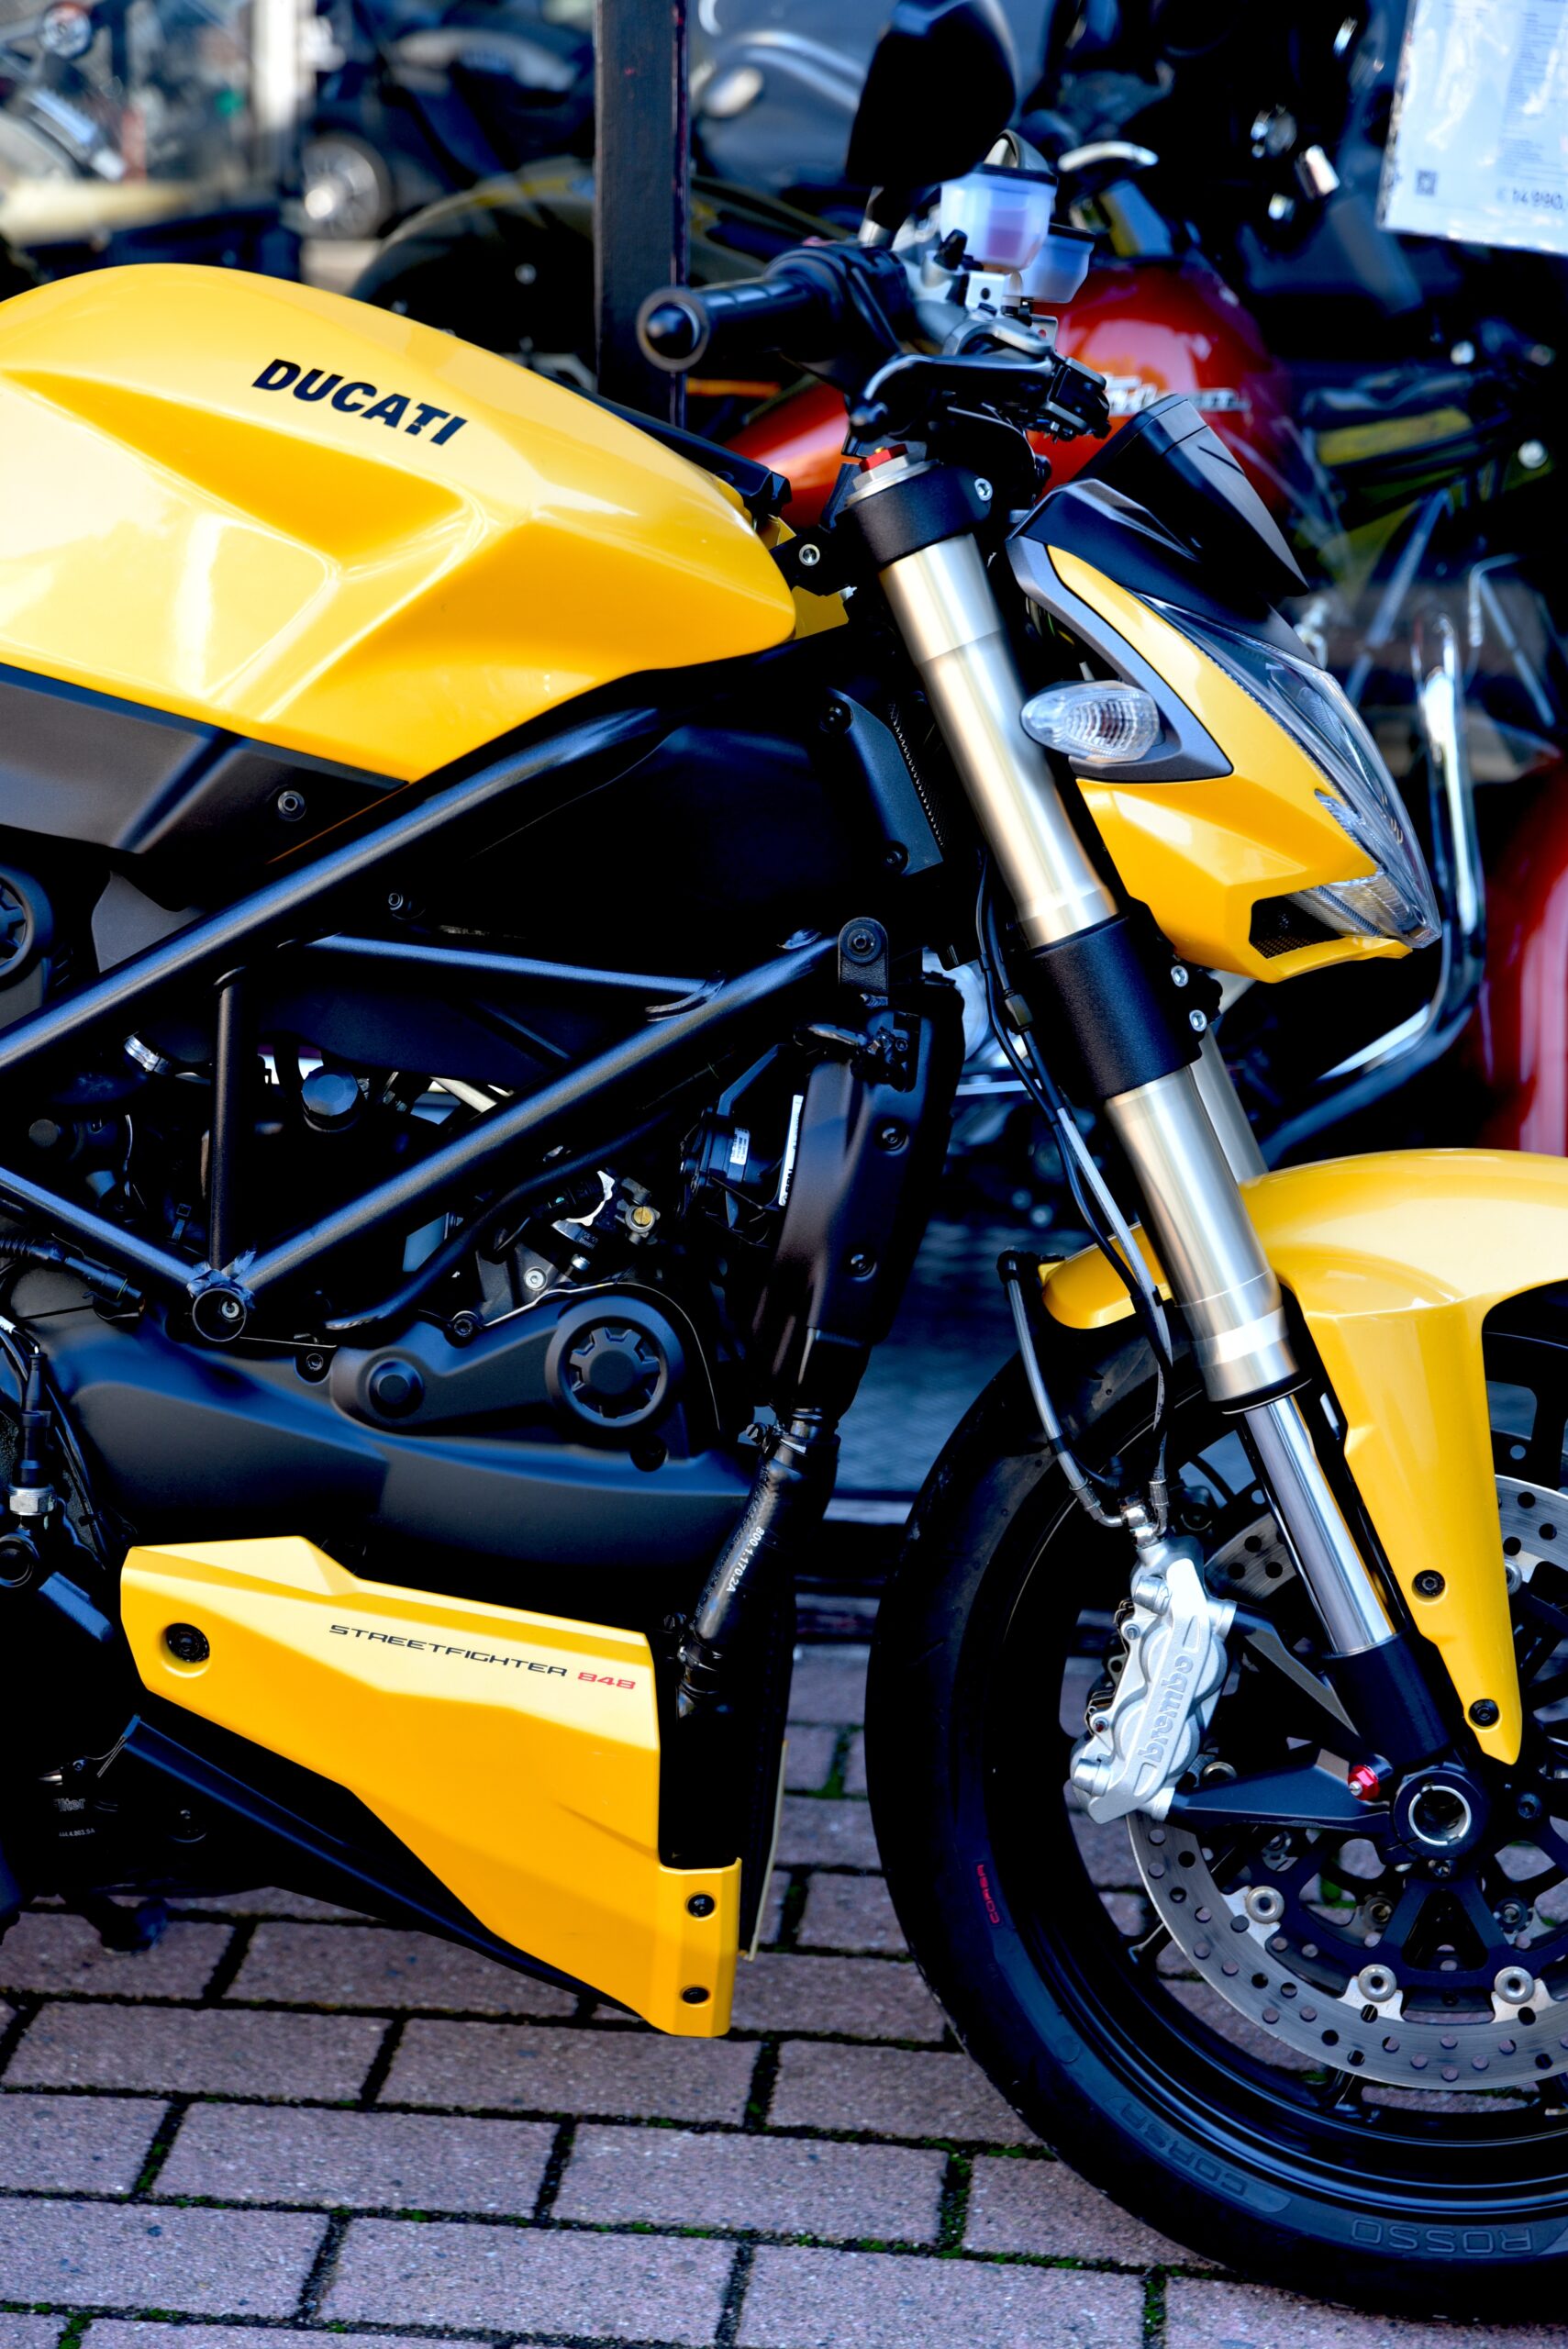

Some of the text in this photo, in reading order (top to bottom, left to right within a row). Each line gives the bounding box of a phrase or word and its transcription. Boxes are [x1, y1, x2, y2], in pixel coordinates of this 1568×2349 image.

[251, 359, 468, 446] DUCATI
[726, 1526, 765, 1592] 800.1.170.2A
[329, 1624, 636, 1690] STREETFIGHTER 848
[1138, 1654, 1194, 1763] brembo
[976, 1865, 1000, 1923] CORSA
[1120, 2102, 1532, 2254] ROSSO CORSA
